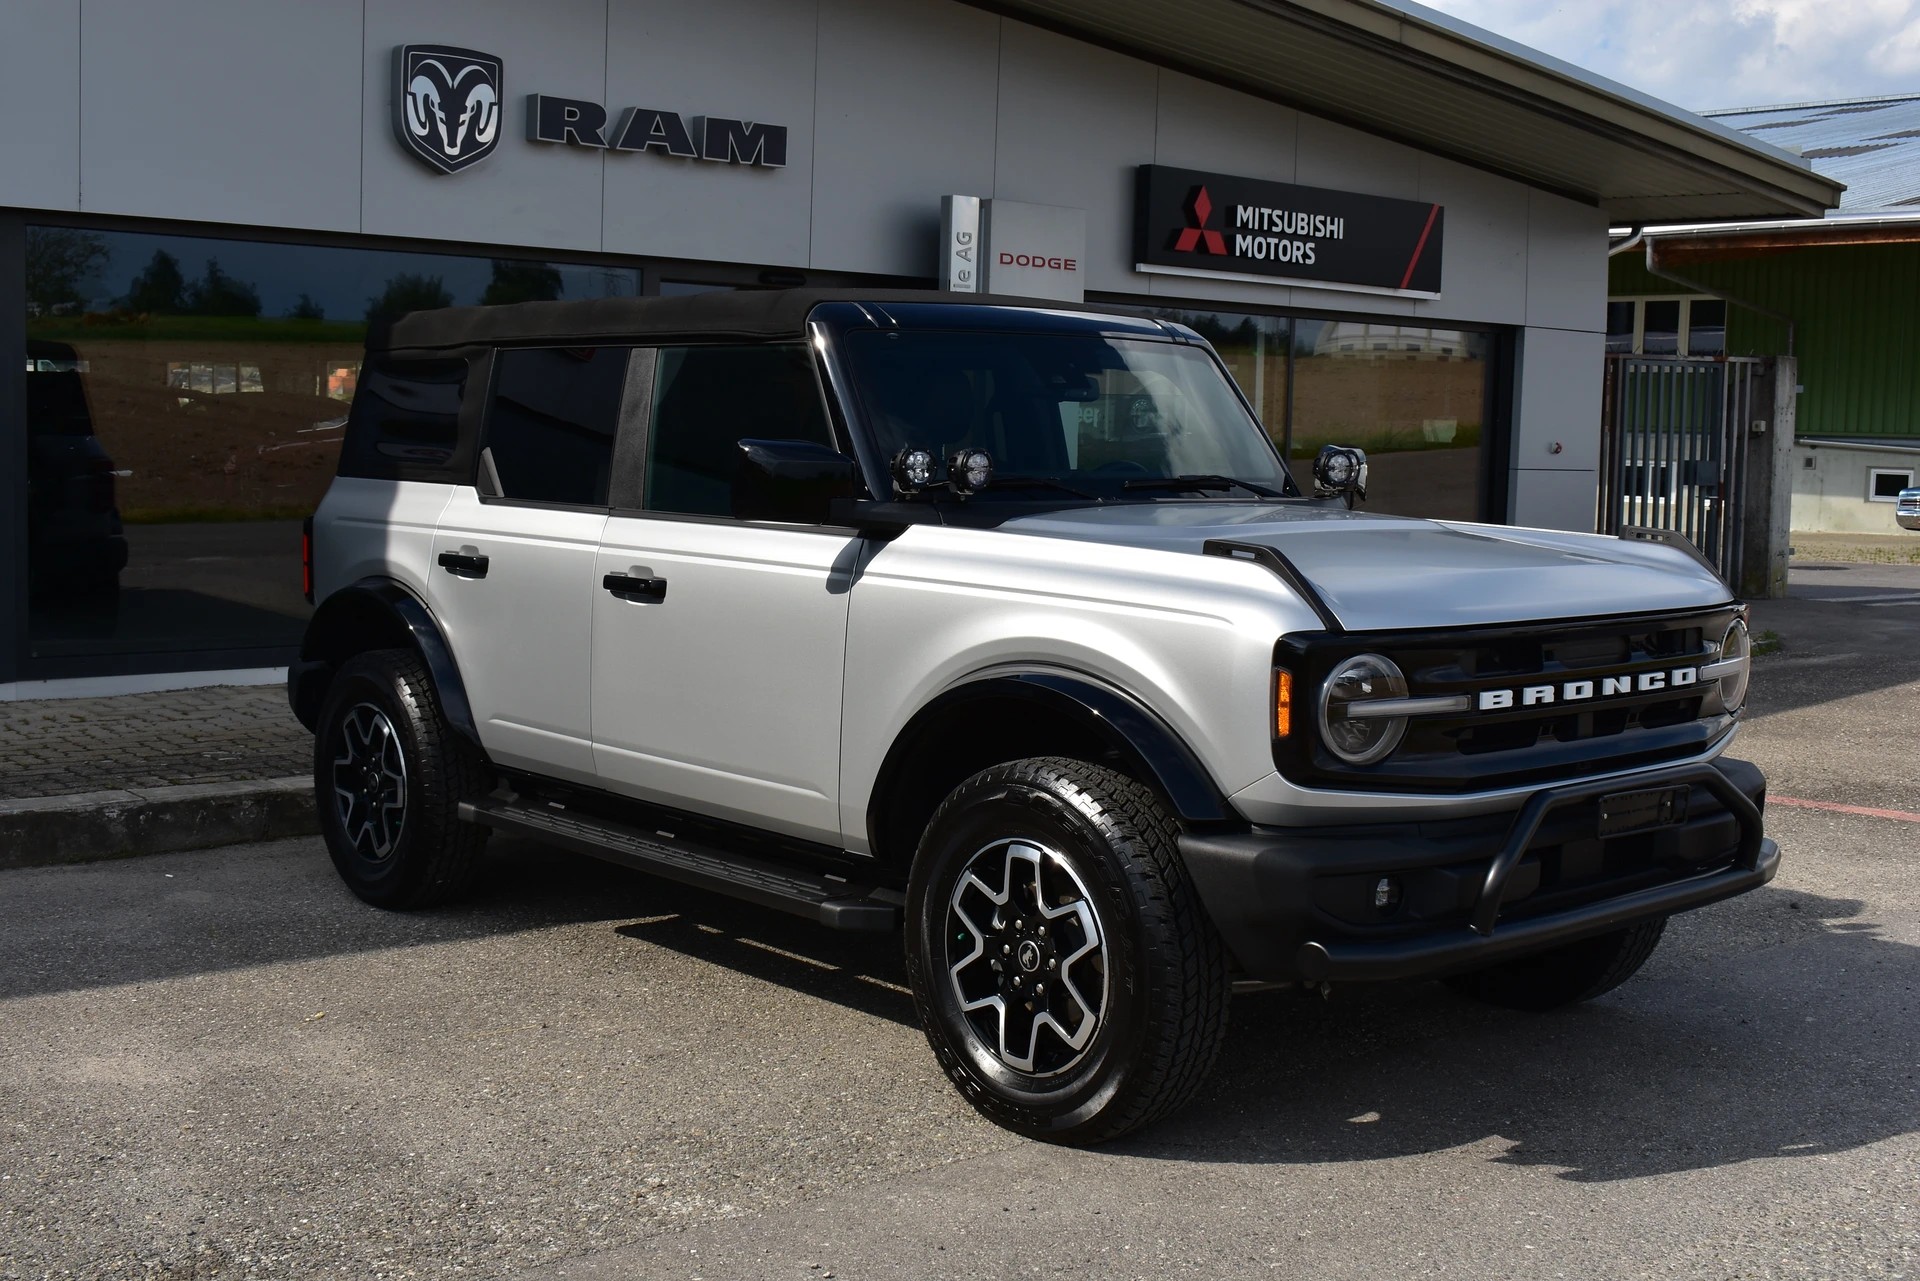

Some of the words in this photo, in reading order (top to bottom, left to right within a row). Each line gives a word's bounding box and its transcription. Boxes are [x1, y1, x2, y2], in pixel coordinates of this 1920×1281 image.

[528, 93, 788, 168] RAM
[1236, 204, 1344, 240] MITSUBISHI
[955, 231, 973, 263] AG
[999, 252, 1077, 271] DODGE
[1235, 234, 1316, 265] MOTORS
[1479, 667, 1697, 710] BRONCO
